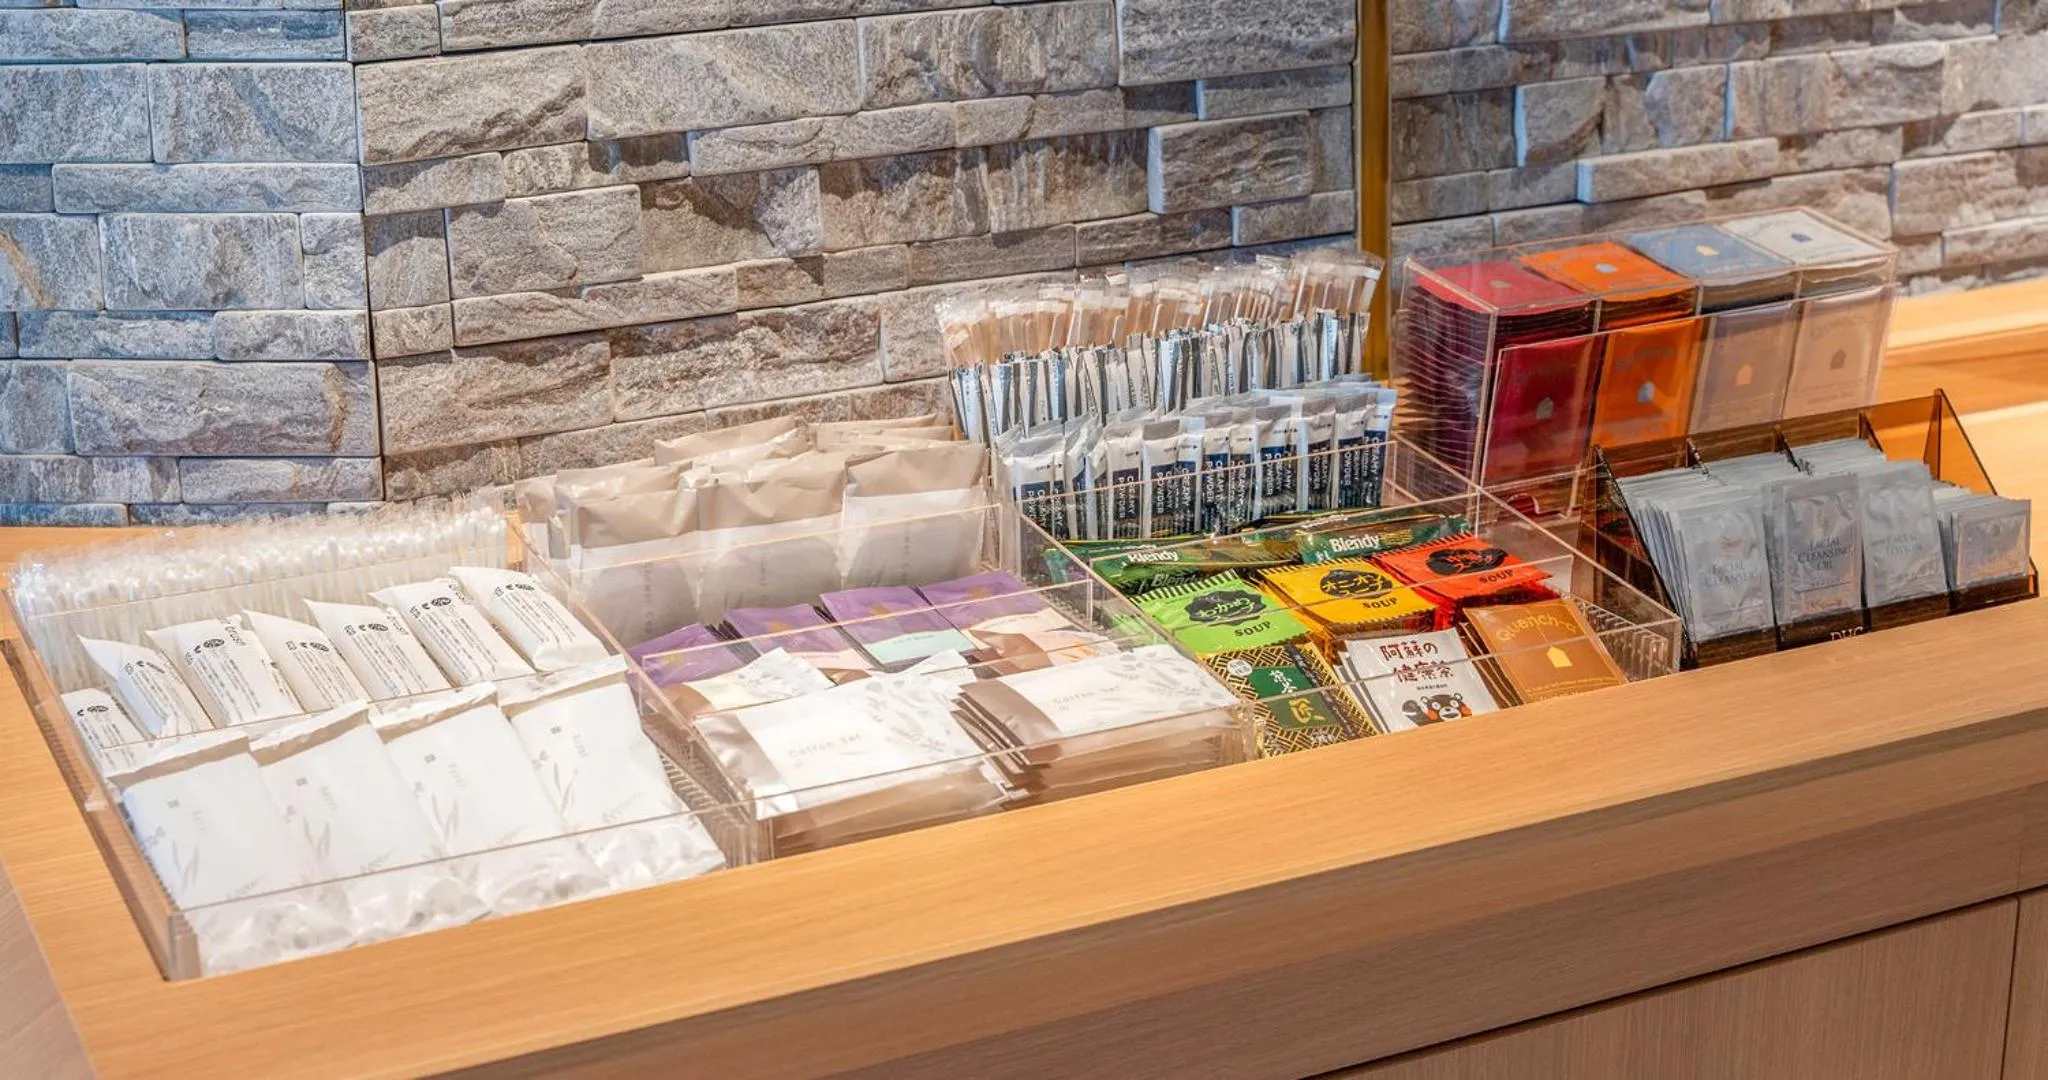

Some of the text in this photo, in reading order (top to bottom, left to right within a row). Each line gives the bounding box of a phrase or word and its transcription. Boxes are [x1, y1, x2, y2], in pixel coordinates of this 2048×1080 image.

[1118, 477, 1126, 519] POWDER
[1127, 475, 1136, 515] CREAMY
[1329, 533, 1380, 552] Blendy
[1479, 568, 1513, 583] SOUP
[1363, 597, 1398, 609] SOUP
[1235, 620, 1271, 637] SOUP
[1380, 640, 1438, 661] 阿蘇の
[1393, 660, 1454, 683] 健康茶
